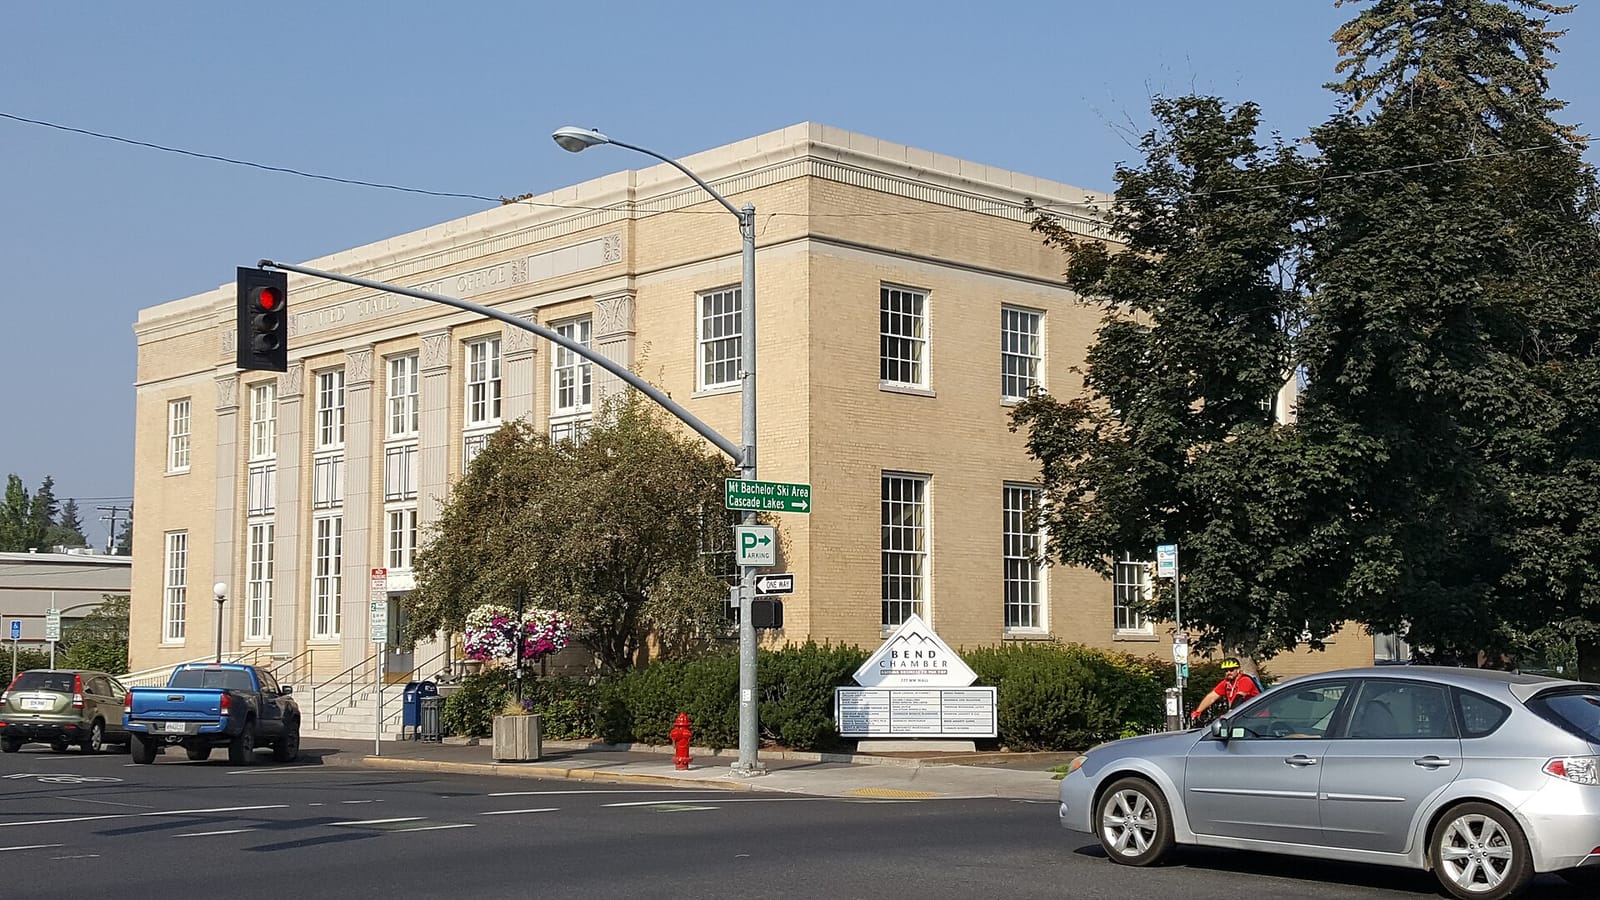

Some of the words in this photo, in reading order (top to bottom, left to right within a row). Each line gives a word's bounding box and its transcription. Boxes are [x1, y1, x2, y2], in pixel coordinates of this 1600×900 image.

[456, 266, 506, 293] OFFICE
[728, 481, 738, 493] Mt
[741, 482, 774, 495] Bachelor
[777, 485, 789, 497] Ski
[791, 486, 809, 497] Area
[729, 495, 760, 508] Cascade
[763, 497, 785, 509] Lakes
[766, 581, 777, 589] ONE
[779, 580, 790, 588] WAY
[891, 650, 936, 659] BEND
[880, 660, 948, 668] CHAMBER
